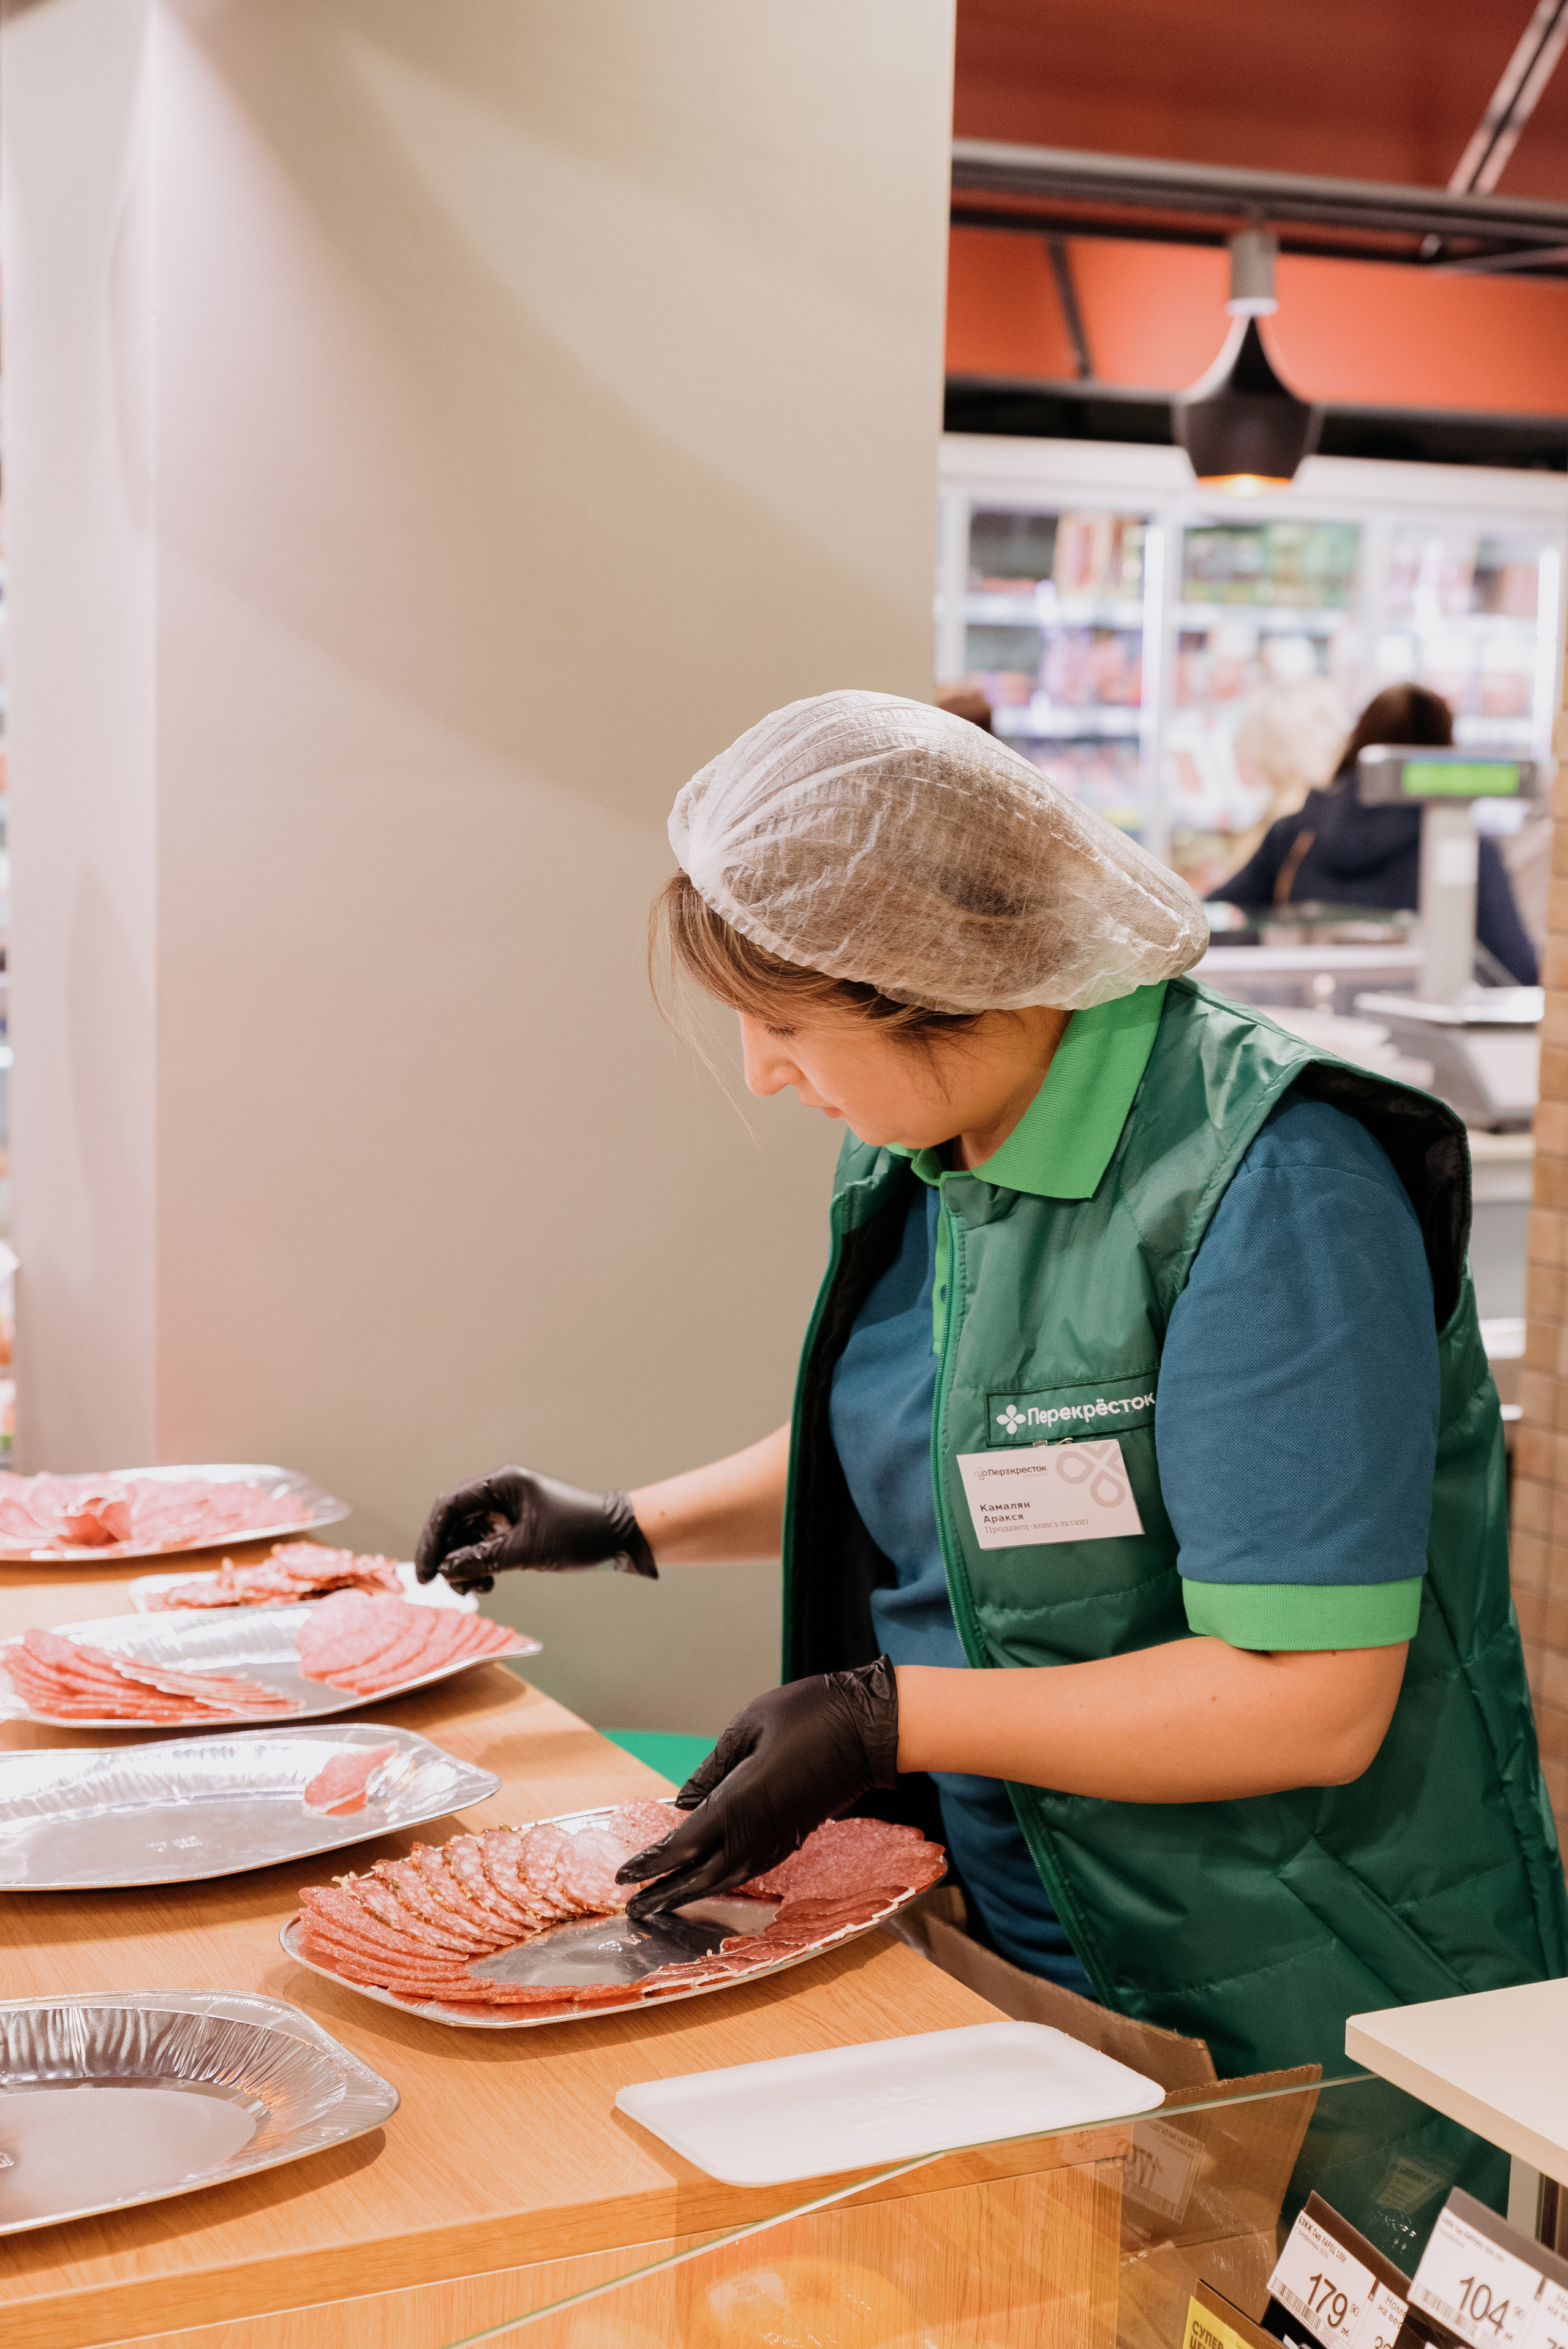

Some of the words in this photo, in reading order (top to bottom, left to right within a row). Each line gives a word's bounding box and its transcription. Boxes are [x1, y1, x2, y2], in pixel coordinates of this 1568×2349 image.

[1028, 1393, 1156, 1427] Перекрёсток
[980, 1502, 1031, 1511] Камалян
[984, 1514, 1024, 1524] Аракся
[986, 1519, 1090, 1534] Продавец-консультант
[1298, 2215, 1313, 2232] БЗМЖ
[1312, 2228, 1321, 2242] Сыр
[1321, 2236, 1336, 2255] ЛАРЕЦ
[1308, 2273, 1348, 2328] 179
[1460, 2275, 1509, 2336] 104
[1350, 2303, 1359, 2317] 90
[1378, 2304, 1387, 2316] на
[1547, 2304, 1558, 2317] на
